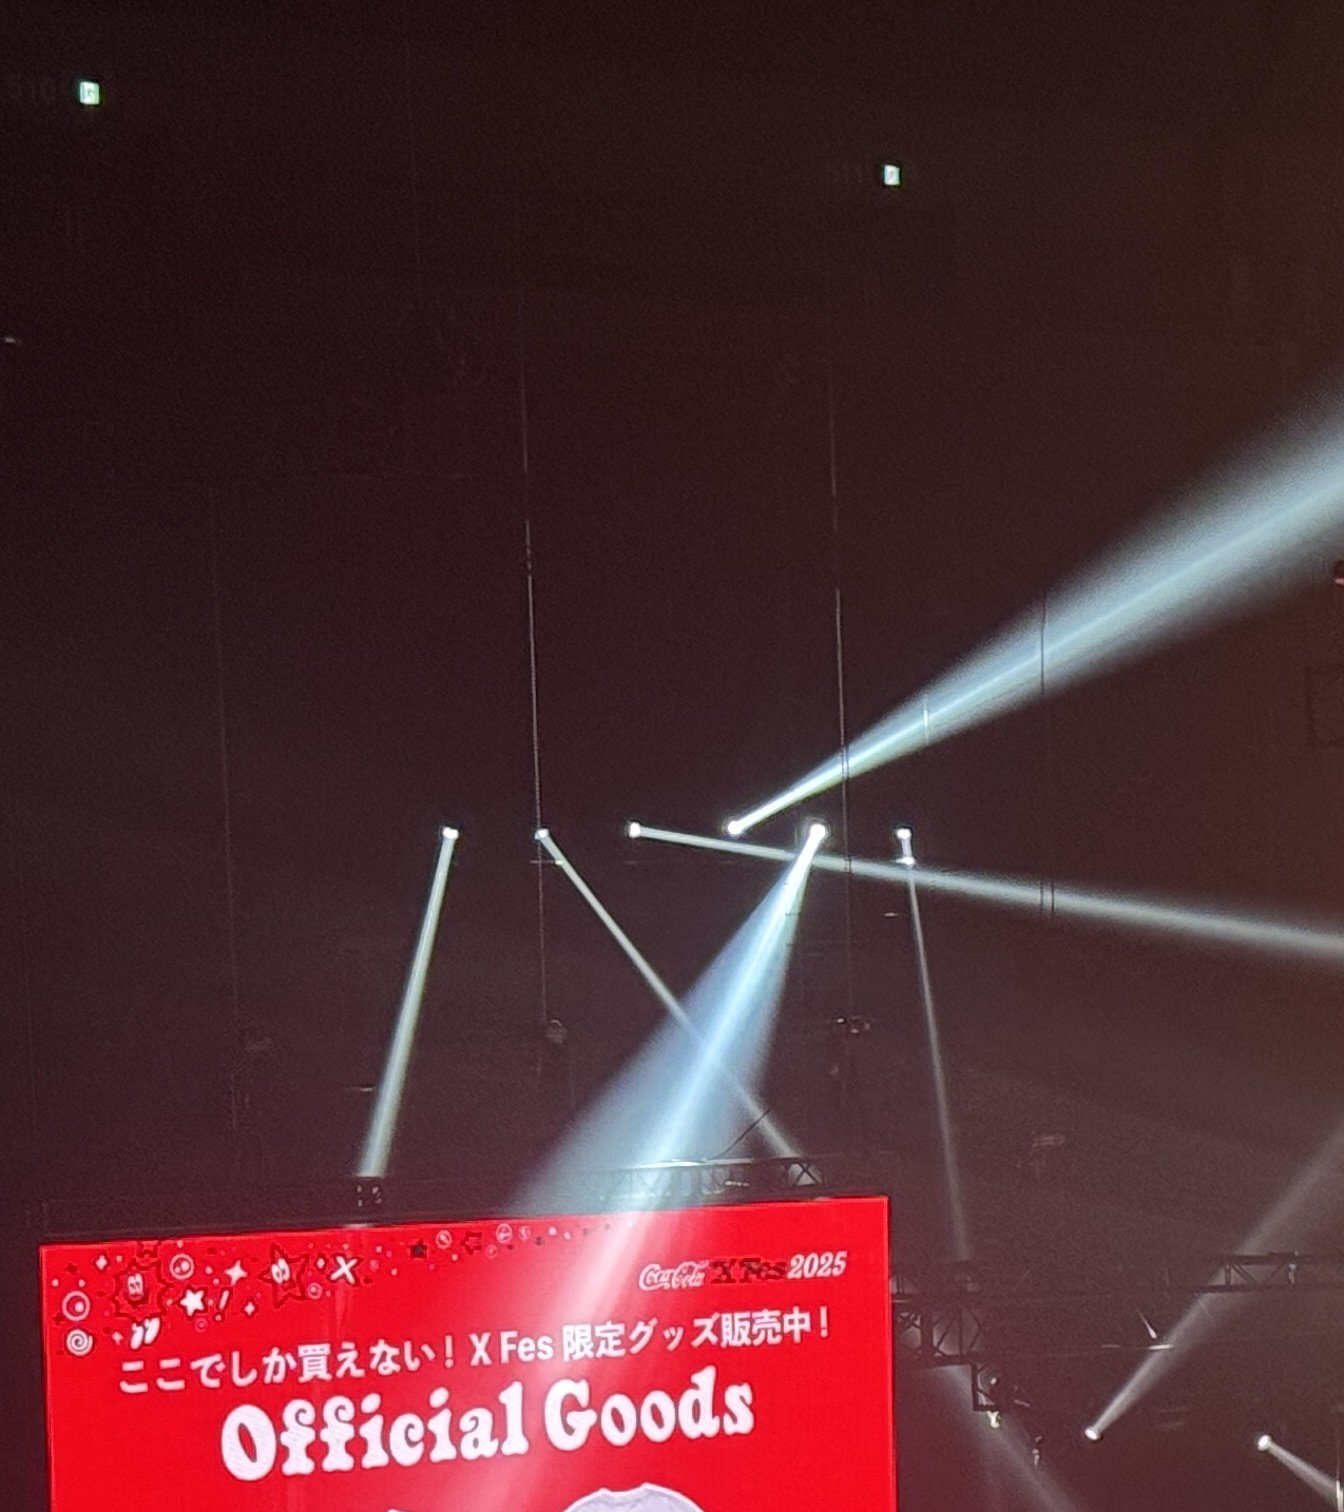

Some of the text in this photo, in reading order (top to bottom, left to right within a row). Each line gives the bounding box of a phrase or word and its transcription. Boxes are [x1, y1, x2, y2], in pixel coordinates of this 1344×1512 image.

[710, 1257, 737, 1285] X
[787, 1250, 848, 1280] 2025
[120, 1305, 830, 1393] ここでしか買えない！ X Fes 限定グッズ販売中！
[221, 1364, 755, 1481] Official Goods
